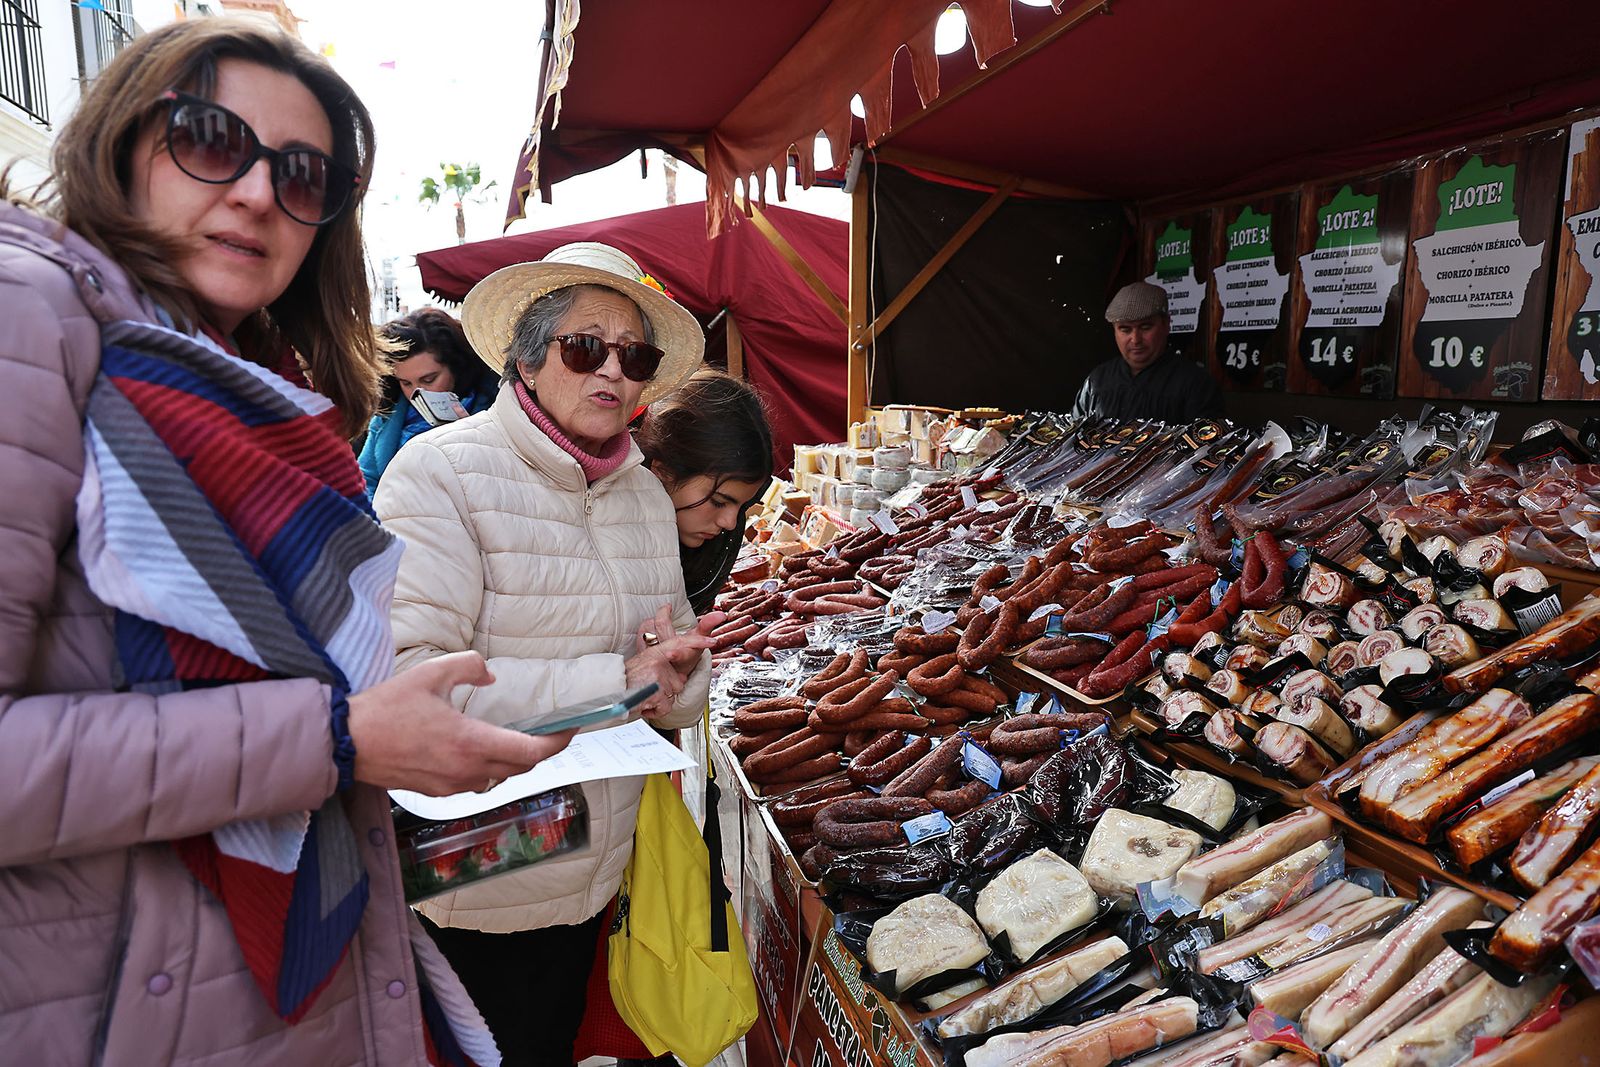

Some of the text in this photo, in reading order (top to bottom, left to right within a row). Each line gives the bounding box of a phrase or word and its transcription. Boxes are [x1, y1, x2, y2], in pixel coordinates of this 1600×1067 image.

[1448, 182, 1504, 215] ¡LOTE!
[1321, 208, 1375, 236] ¡LOTE 2!
[1577, 216, 1600, 235] EM
[1230, 226, 1270, 250] ¡LOTE 3!
[1432, 238, 1521, 257] SALCHICHÓN IBÉRICO
[1158, 241, 1182, 261] ¡LOTE
[1310, 246, 1379, 261] SALCHICHÓN IBÉRICO
[1314, 265, 1373, 277] CHORIZO IBÉRICO
[1436, 265, 1510, 280] CHORIZO IBÉRICO
[1312, 281, 1377, 293] MORCILLA PATATERA
[1428, 290, 1514, 304] MORCILLA PATATERA
[1311, 305, 1382, 315] MORCILLA ACHORIZADA
[1226, 342, 1248, 370] 25
[1251, 349, 1260, 366] €
[1309, 336, 1338, 366] 14
[1342, 346, 1354, 363] €
[1429, 336, 1484, 367] 10 €
